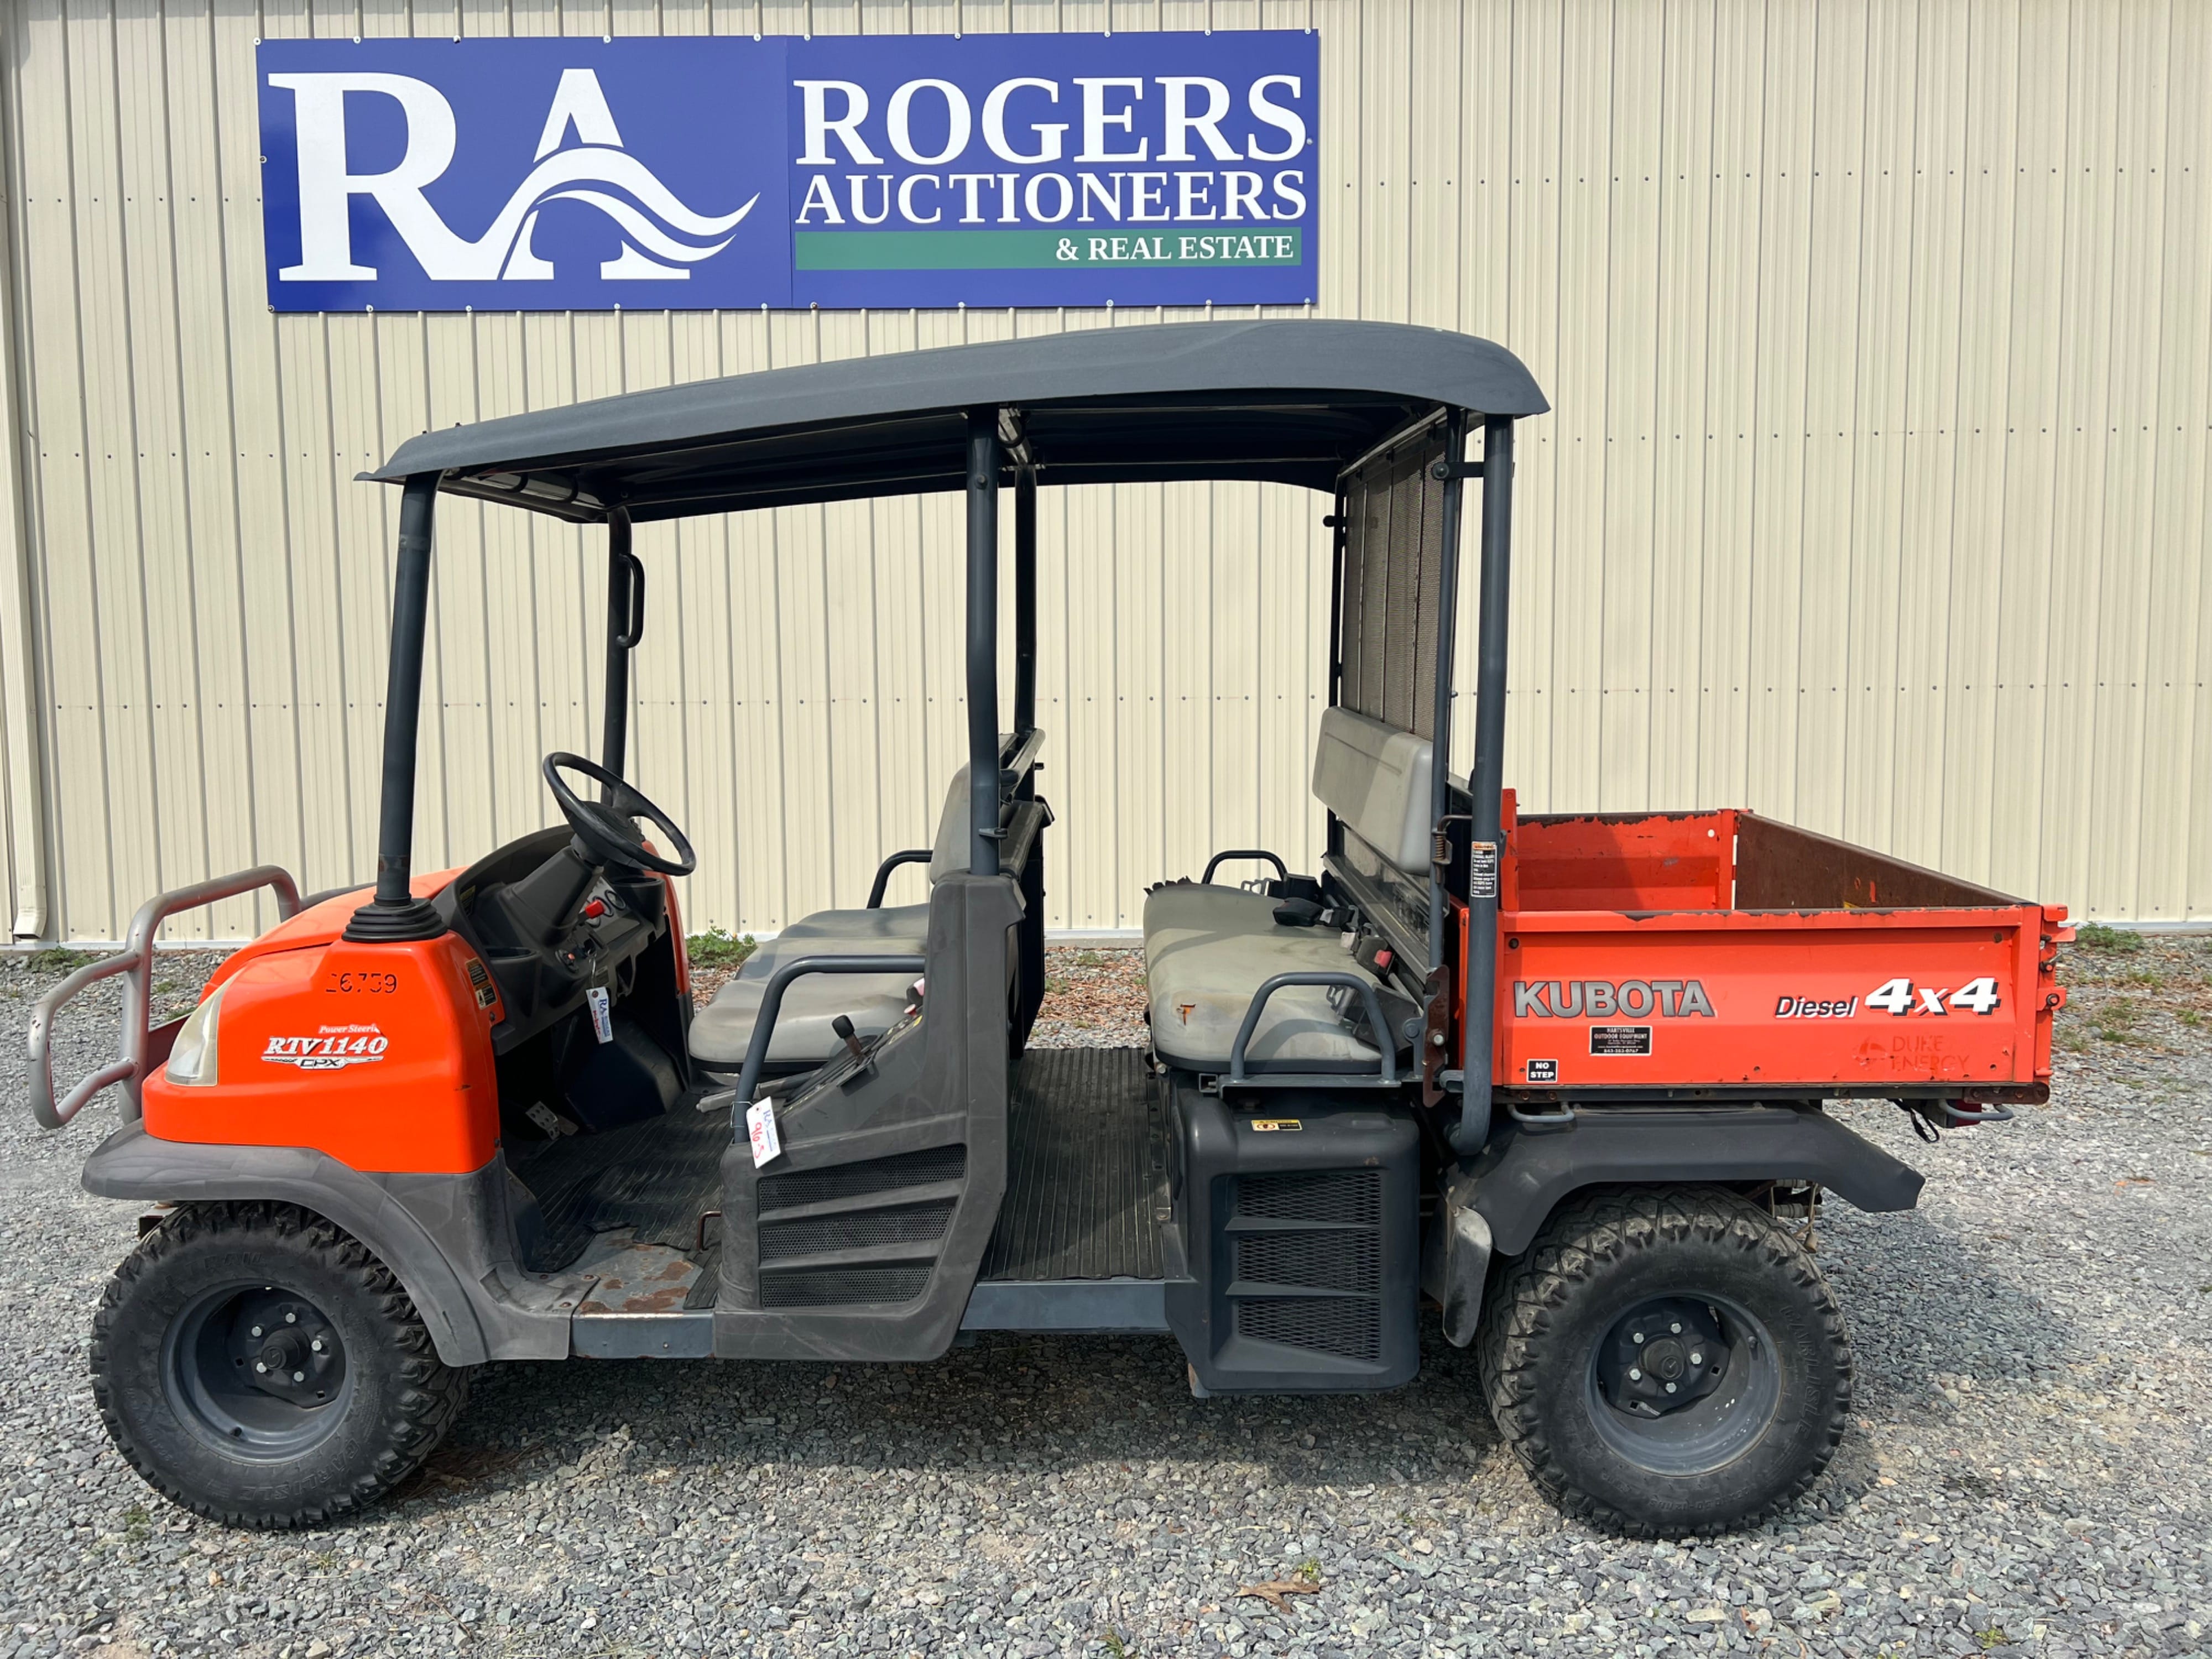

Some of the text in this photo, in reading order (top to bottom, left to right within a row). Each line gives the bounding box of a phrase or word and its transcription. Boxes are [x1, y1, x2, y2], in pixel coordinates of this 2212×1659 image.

[793, 74, 1307, 165] ROGERS
[268, 68, 760, 281] RA
[795, 169, 1307, 224] AUCTIONEERS
[1056, 235, 1293, 261] & REAL ESTATE
[1514, 980, 1716, 1018] KUBOTA
[1773, 977, 2002, 1018] Diesel 4x4
[319, 1024, 382, 1034] Power Steeri
[263, 1036, 388, 1055] RTV1140
[1892, 1035, 1943, 1052] DUKE
[300, 1058, 340, 1067] CPX
[1890, 1055, 1970, 1072] ENERGY
